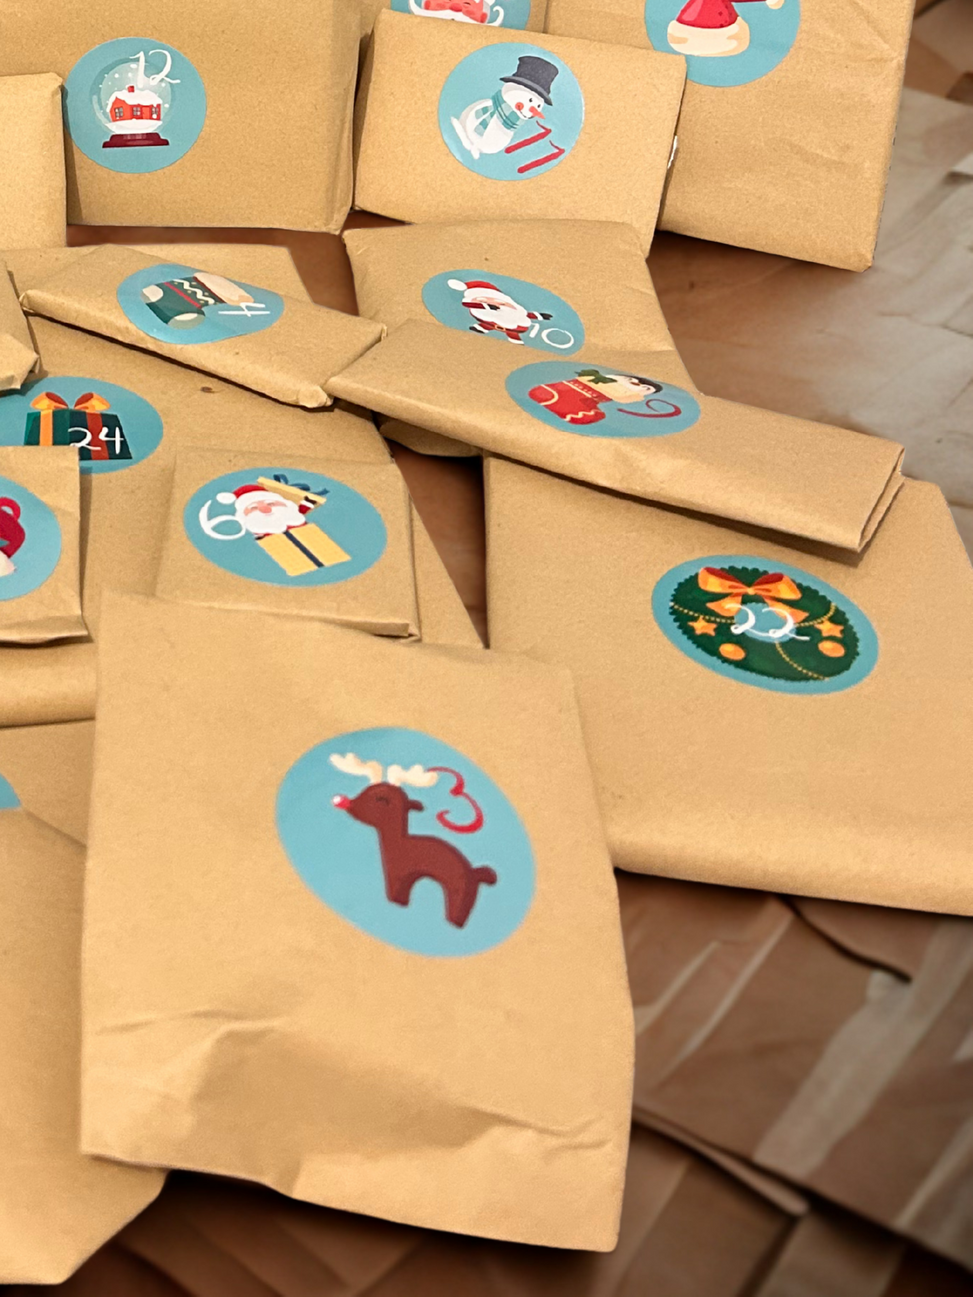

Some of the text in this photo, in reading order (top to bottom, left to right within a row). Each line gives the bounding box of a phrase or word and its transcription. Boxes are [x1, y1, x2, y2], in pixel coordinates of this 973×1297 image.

[129, 49, 180, 84] 12
[505, 120, 565, 173] 11
[218, 302, 270, 317] 4
[528, 323, 575, 349] 10
[617, 398, 682, 420] 9
[68, 426, 124, 454] 24
[198, 500, 245, 540] 6
[729, 602, 811, 641] 22
[428, 766, 483, 833] 3
